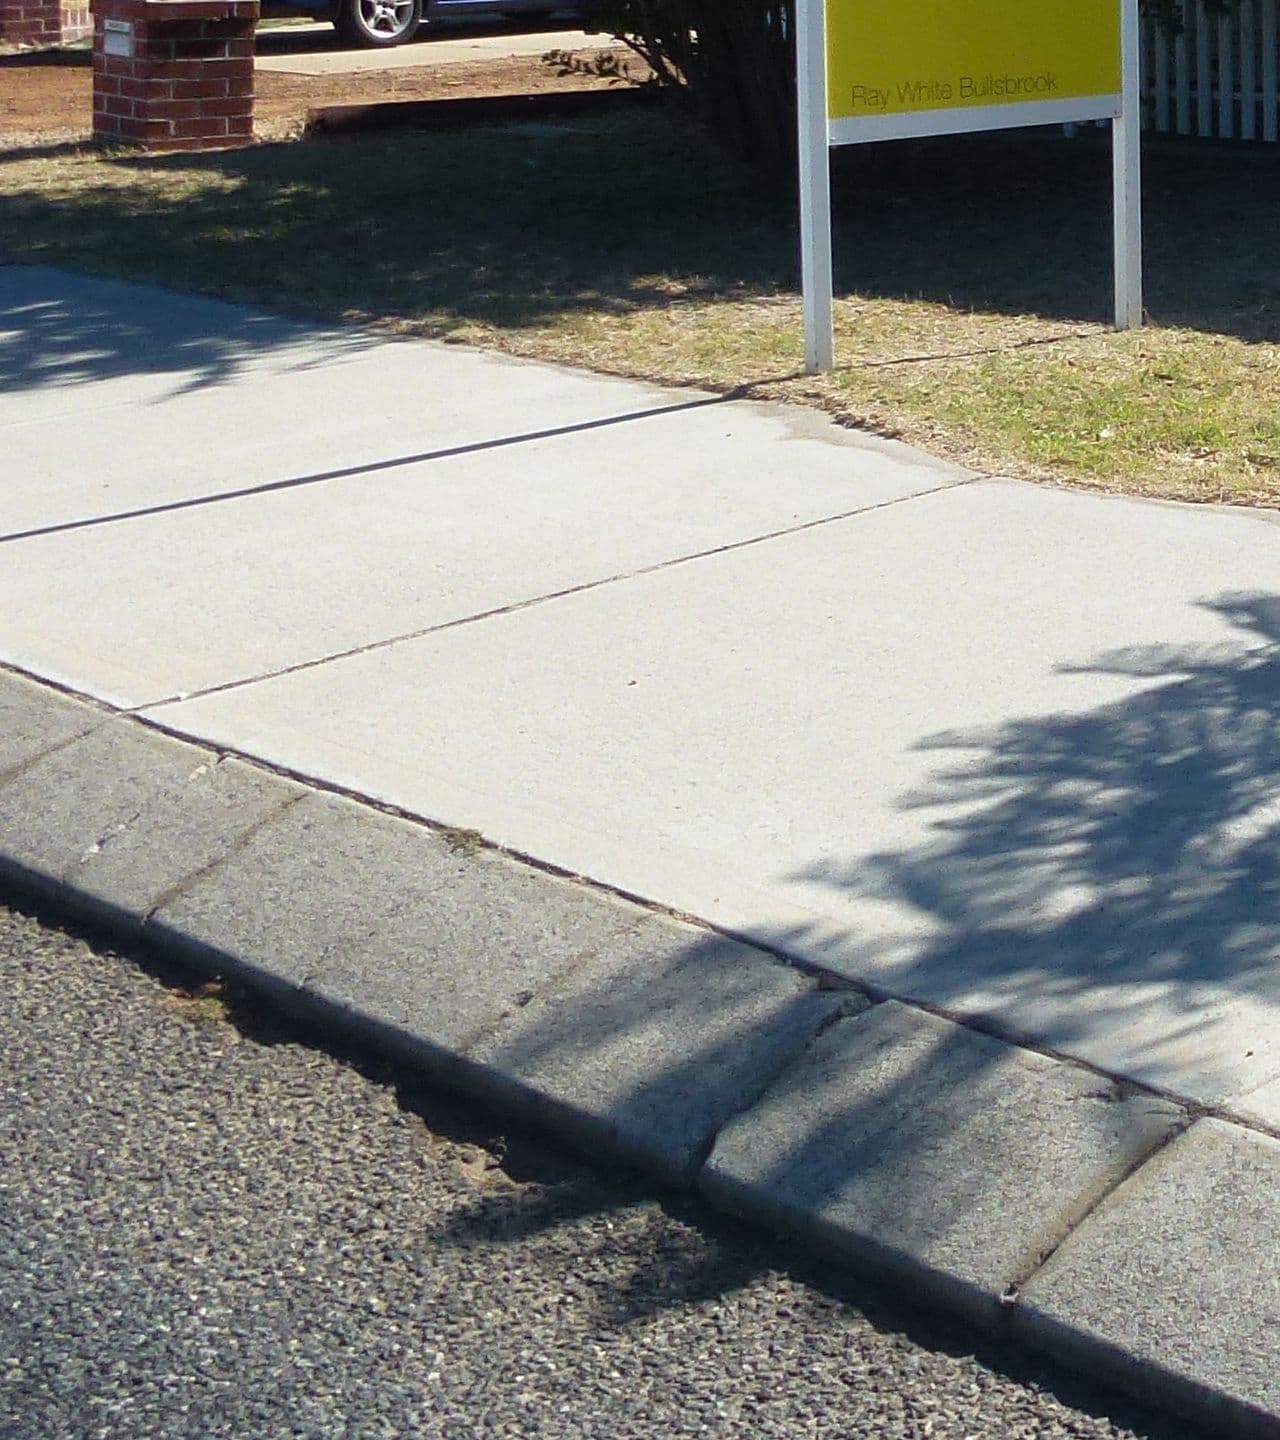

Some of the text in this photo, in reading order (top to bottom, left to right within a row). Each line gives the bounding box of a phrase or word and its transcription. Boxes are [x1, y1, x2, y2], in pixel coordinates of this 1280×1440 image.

[851, 72, 1057, 110] Ray White Bullsbrook
